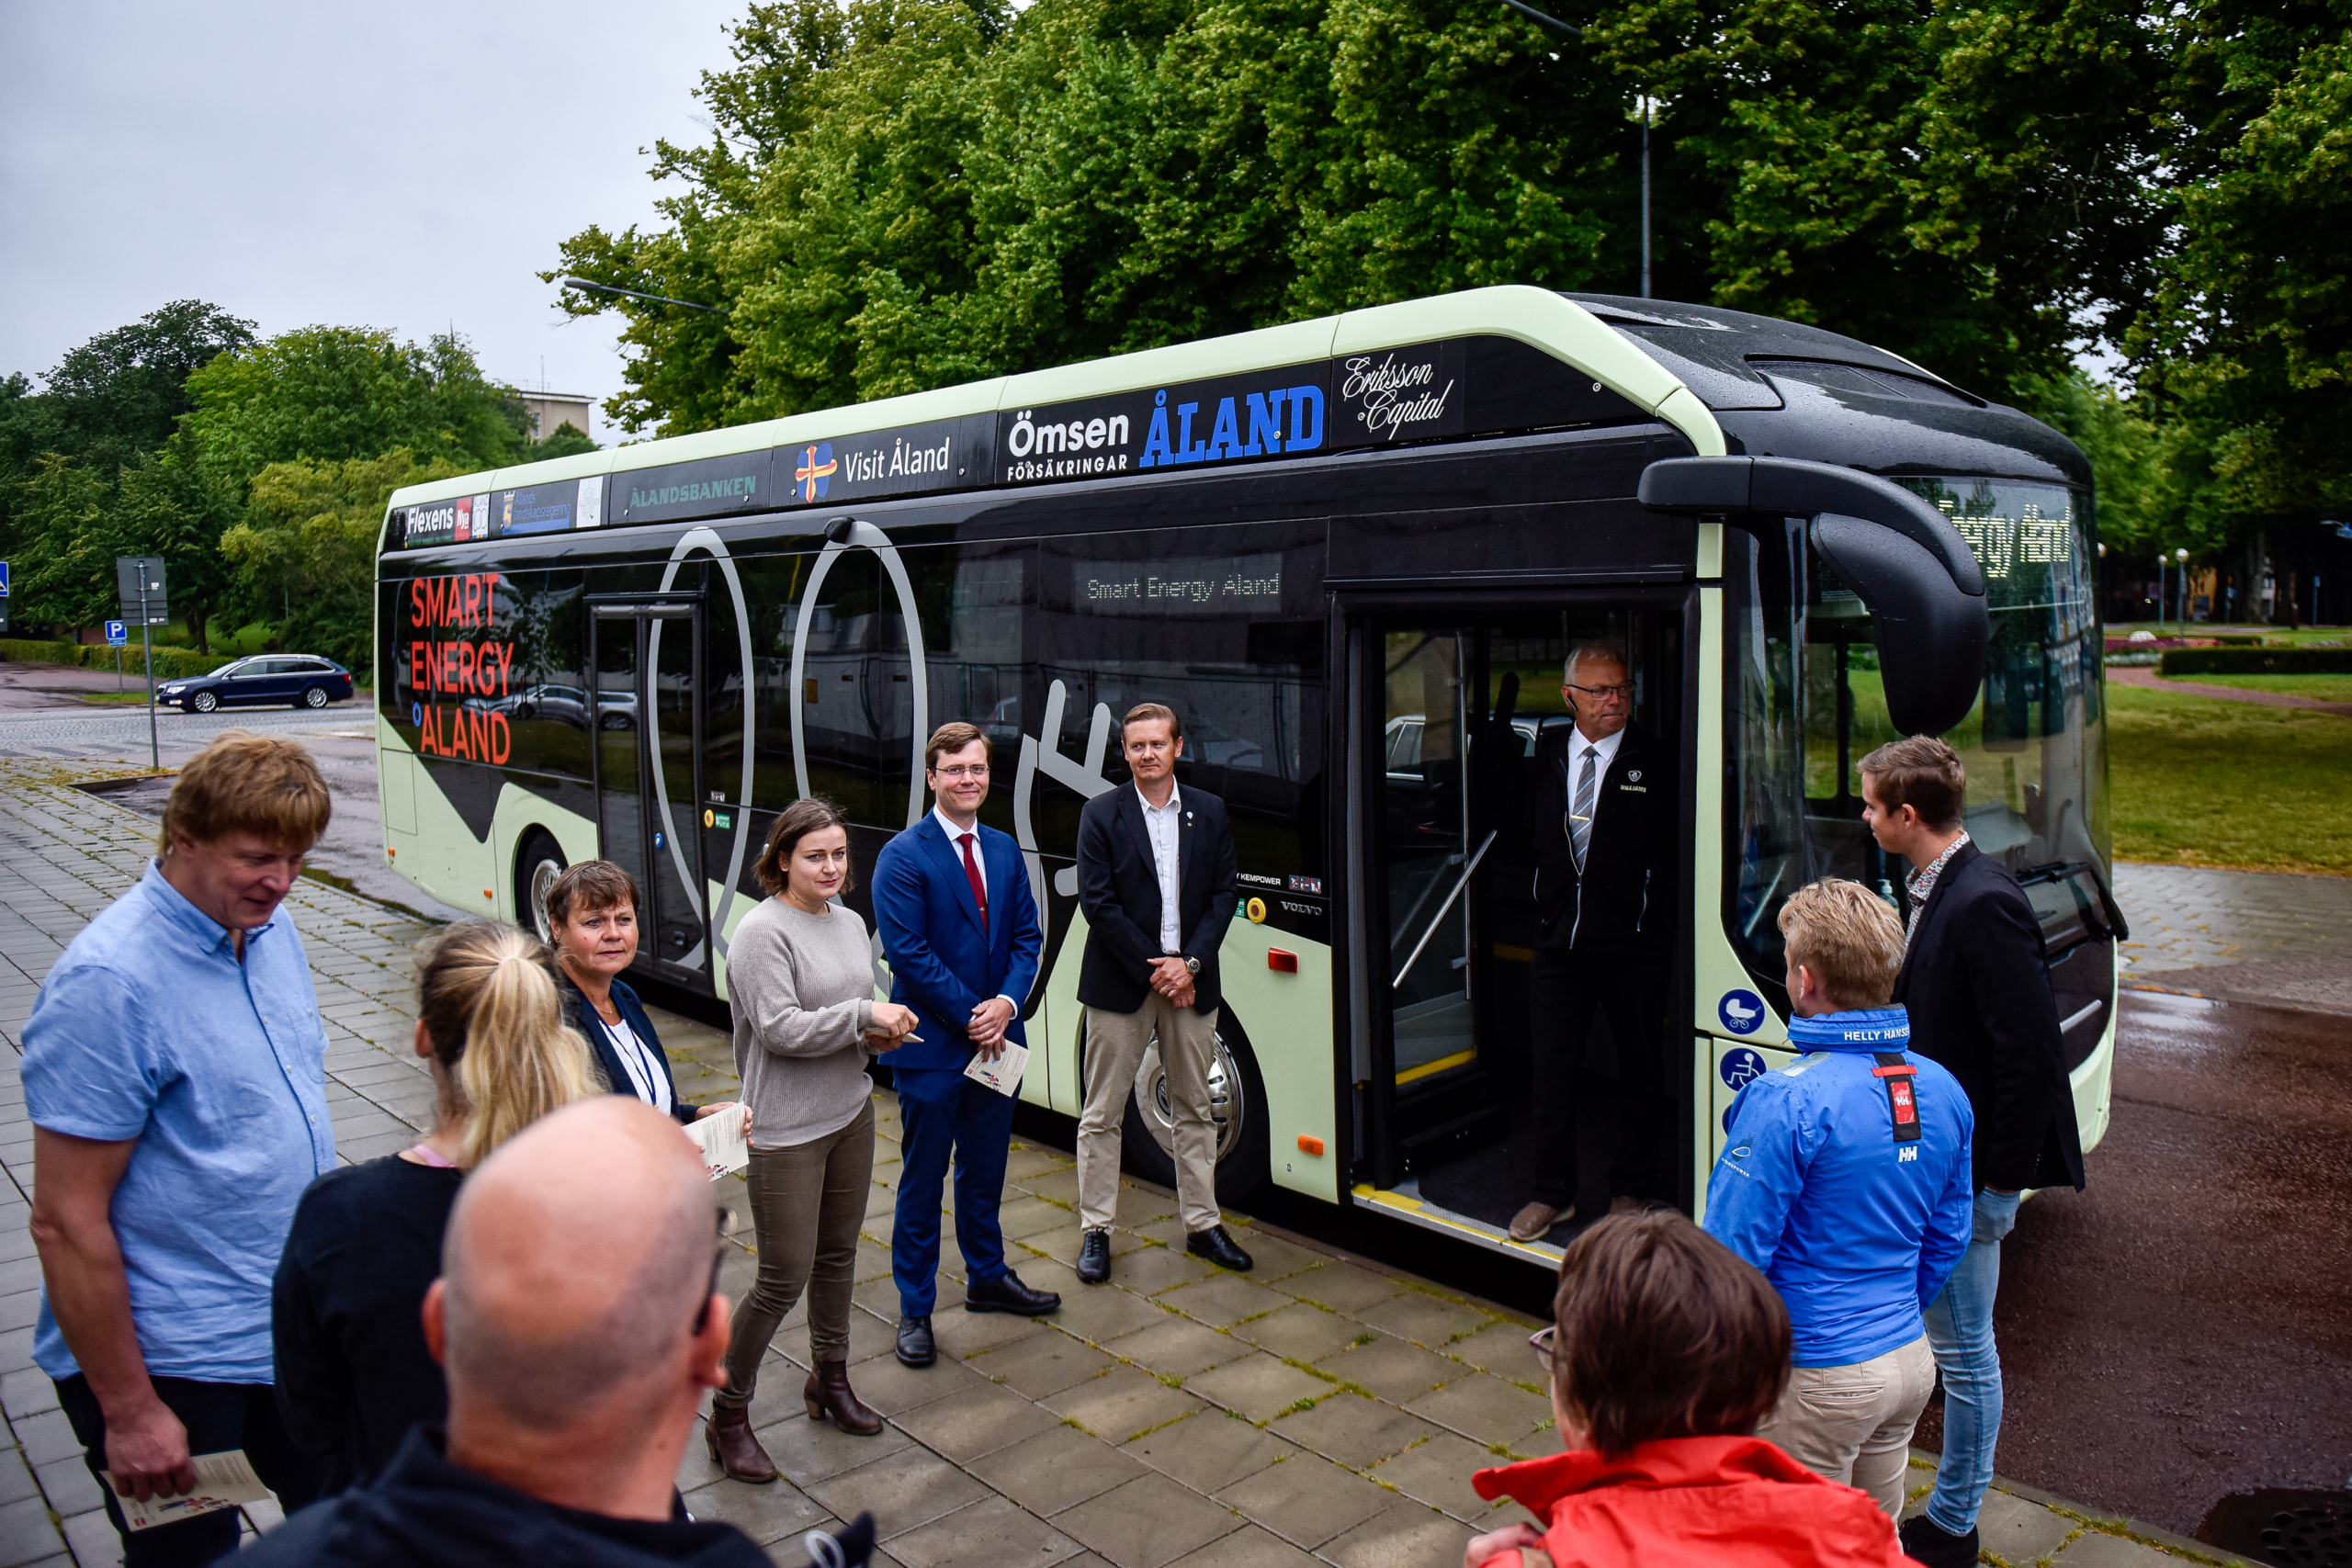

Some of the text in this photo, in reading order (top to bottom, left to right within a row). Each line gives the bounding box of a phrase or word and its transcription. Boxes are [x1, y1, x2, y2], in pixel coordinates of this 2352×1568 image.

[1343, 354, 1432, 401] Eriksson
[1363, 379, 1453, 440] Capital
[1008, 410, 1128, 457] Ömsen
[1139, 385, 1323, 468] ÅLAND
[845, 436, 950, 482] Visit Åland
[1007, 455, 1127, 481] FÖRSÄKRINGAR
[630, 476, 756, 508] ÅLANDSBANKEN
[407, 506, 454, 534] Flexens
[412, 573, 499, 628] SMART
[1088, 578, 1140, 598] Smart
[1148, 577, 1215, 602] Energy
[110, 622, 123, 637] P
[413, 641, 514, 696] ENERGY
[1240, 873, 1281, 886] KEMPOWER
[1281, 900, 1322, 916] VOLVO
[1844, 1027, 1909, 1041] HELLY HANSE
[1896, 1095, 1909, 1106] HH
[1898, 1145, 1917, 1163] HH
